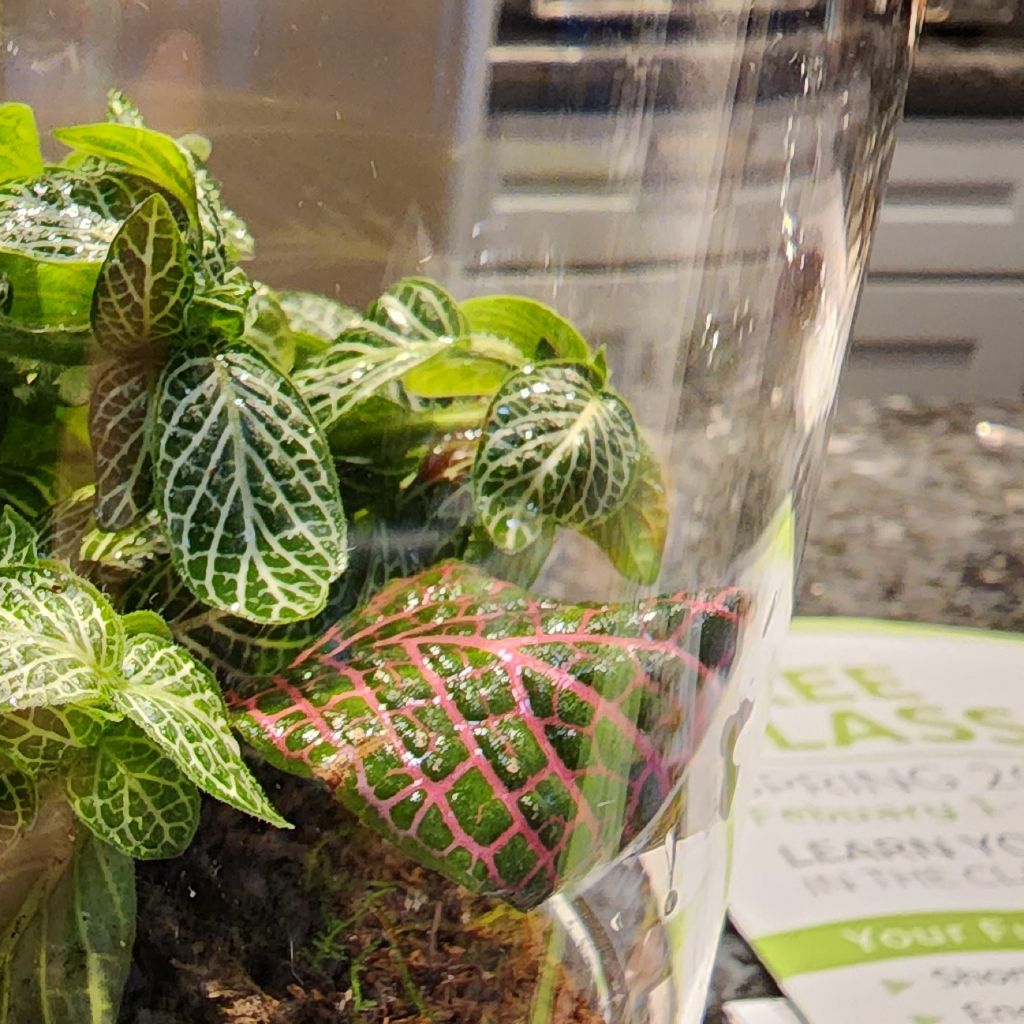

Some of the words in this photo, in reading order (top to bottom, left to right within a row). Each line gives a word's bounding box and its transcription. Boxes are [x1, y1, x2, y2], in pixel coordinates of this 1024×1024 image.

[773, 665, 924, 706] EE
[763, 704, 1024, 750] LASS
[778, 836, 957, 868] LEARN
[957, 832, 1024, 859] YO
[839, 921, 968, 954] Your
